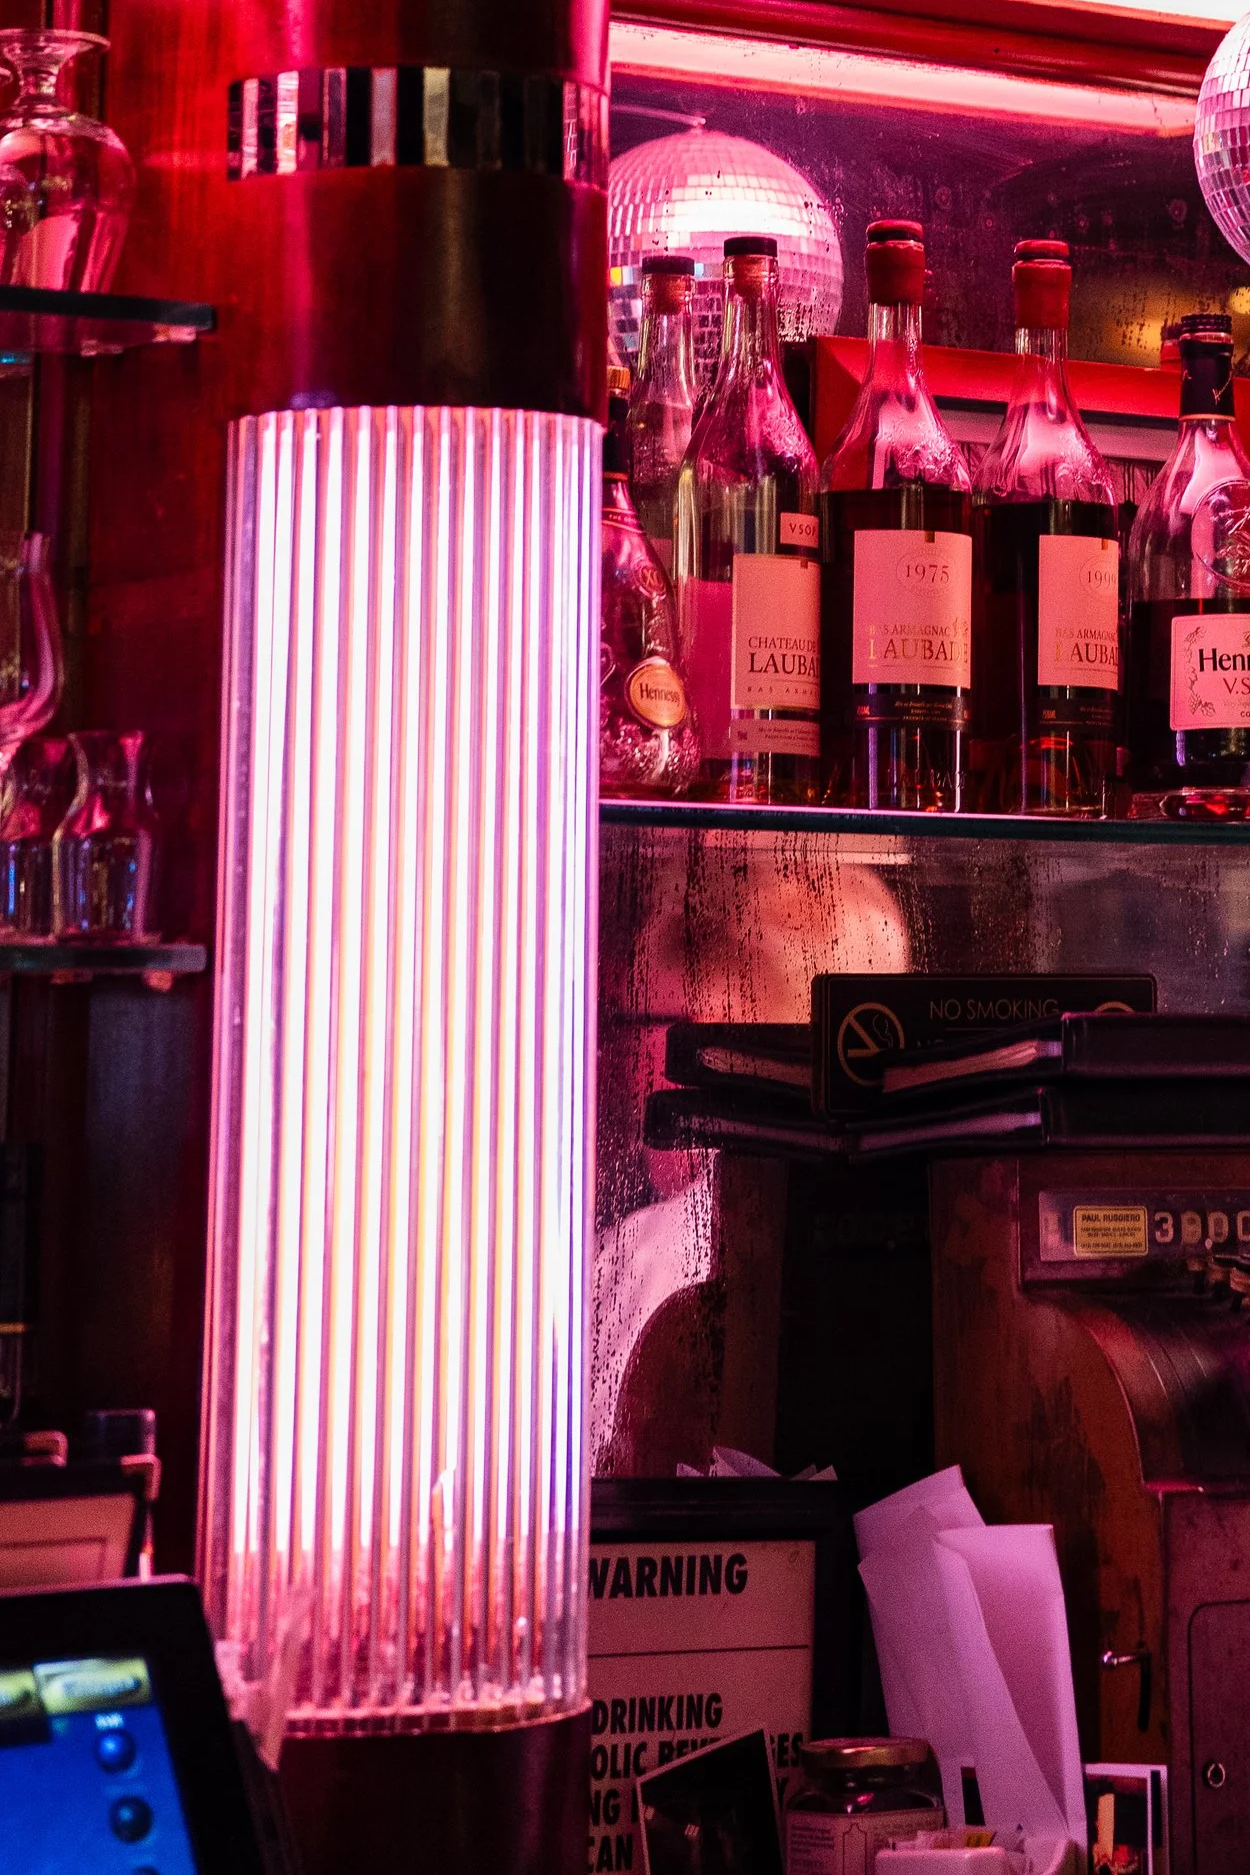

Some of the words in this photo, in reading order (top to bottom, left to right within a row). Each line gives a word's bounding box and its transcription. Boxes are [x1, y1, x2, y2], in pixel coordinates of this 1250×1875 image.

[905, 564, 950, 584] 1975
[748, 636, 805, 652] CHATEAU
[639, 682, 681, 703] Hennessy
[929, 998, 962, 1021] NO
[966, 998, 1059, 1022] SMOKING
[1081, 1213, 1101, 1223] PAUL
[592, 1693, 723, 1736] DRINKING
